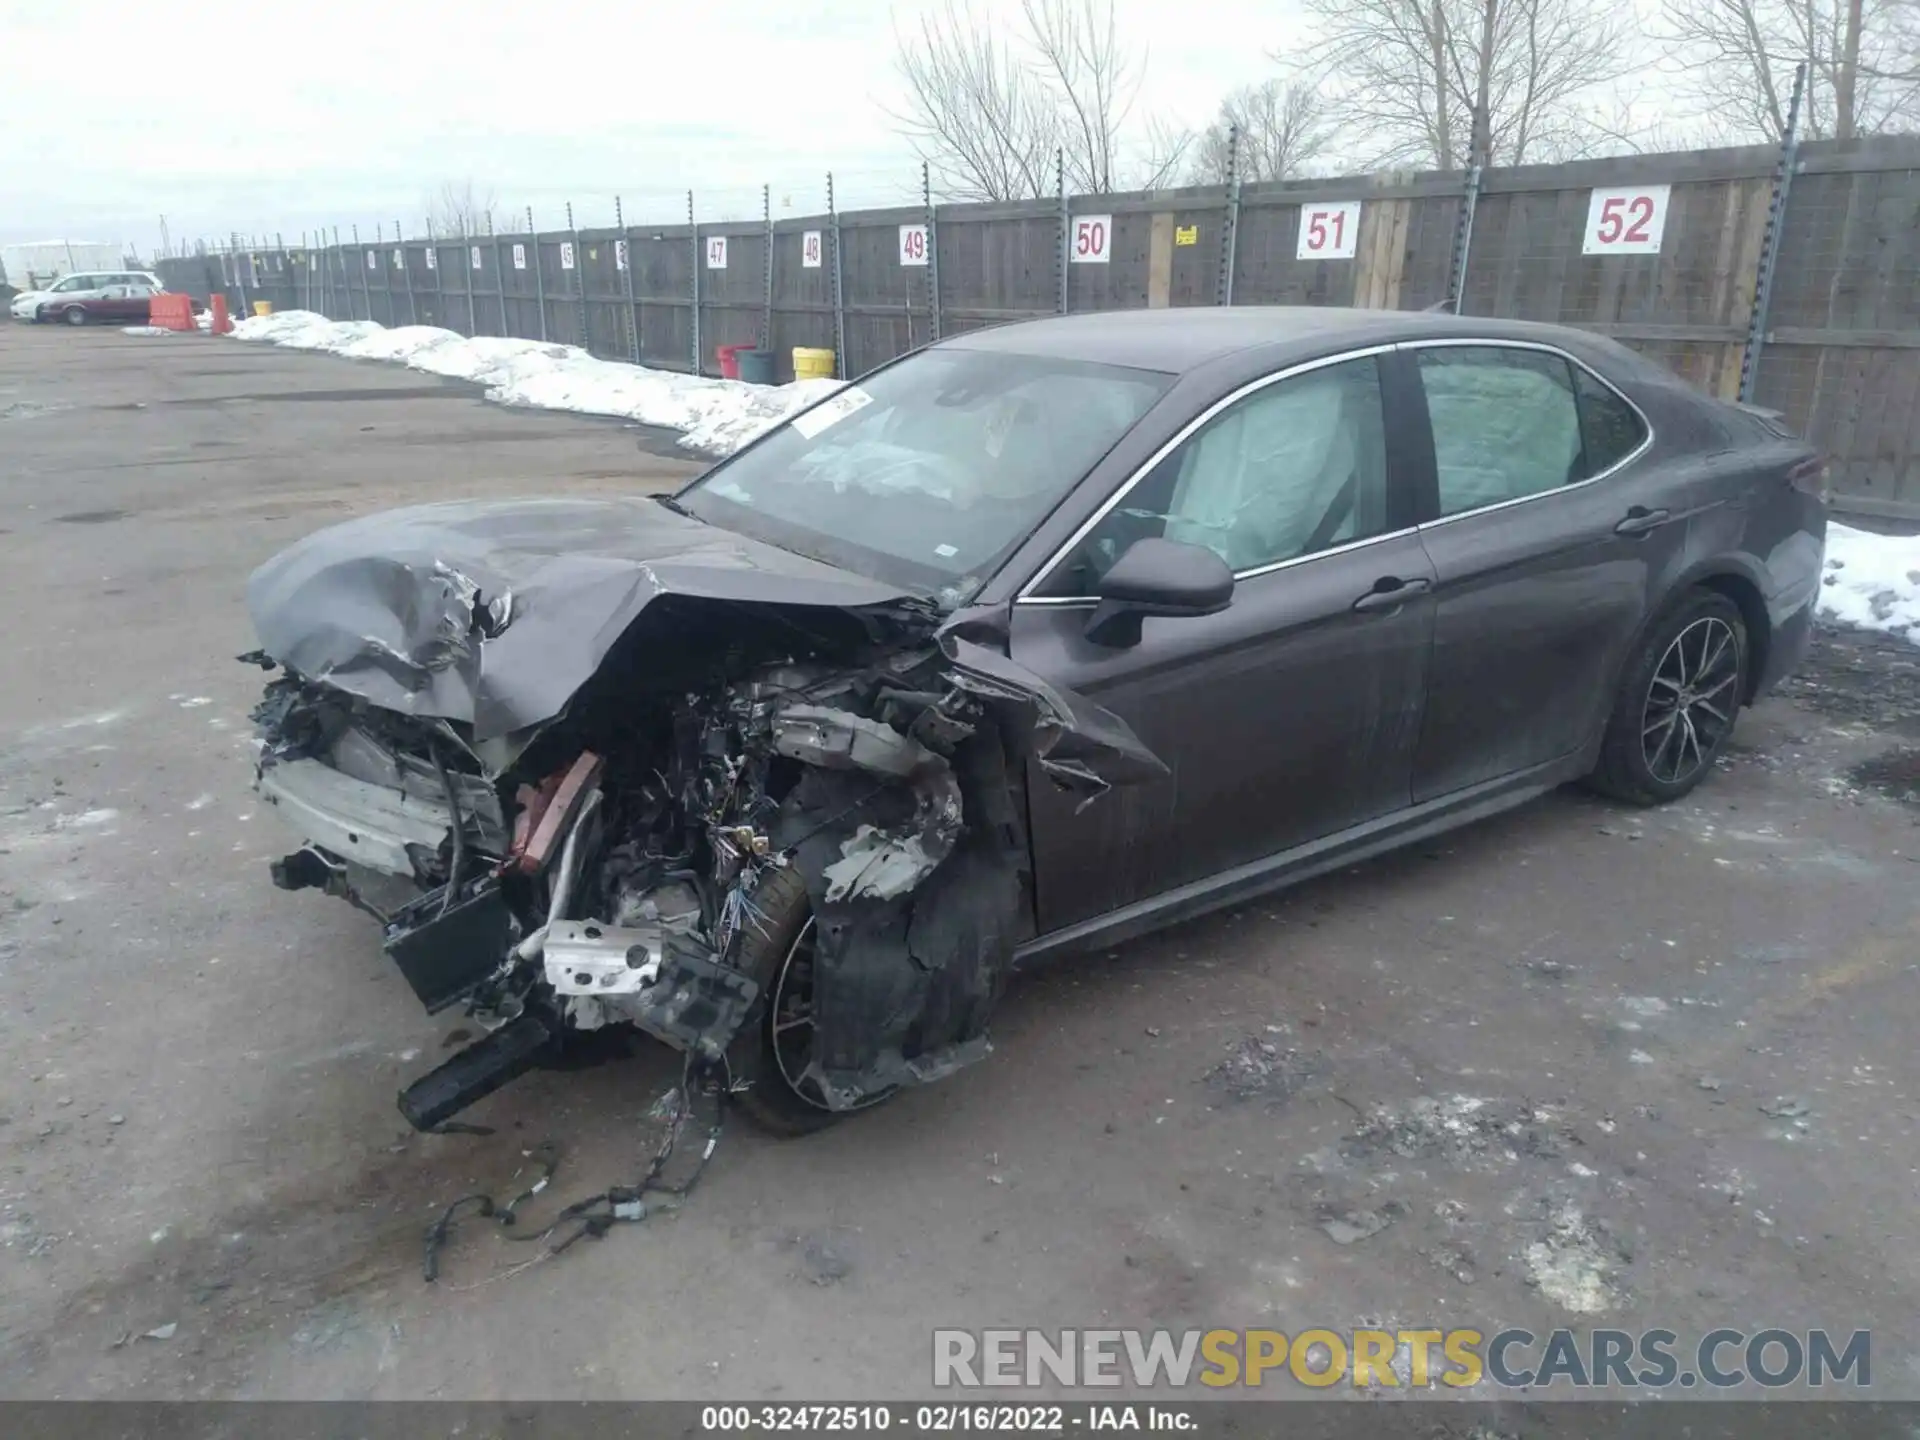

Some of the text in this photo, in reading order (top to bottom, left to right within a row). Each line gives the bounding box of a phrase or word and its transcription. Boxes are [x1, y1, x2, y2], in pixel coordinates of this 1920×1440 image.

[1307, 210, 1345, 250] 51
[1597, 196, 1654, 244] 52
[710, 240, 724, 263] 47
[805, 235, 818, 261] 48
[904, 231, 924, 259] 49
[1077, 222, 1104, 255] 50
